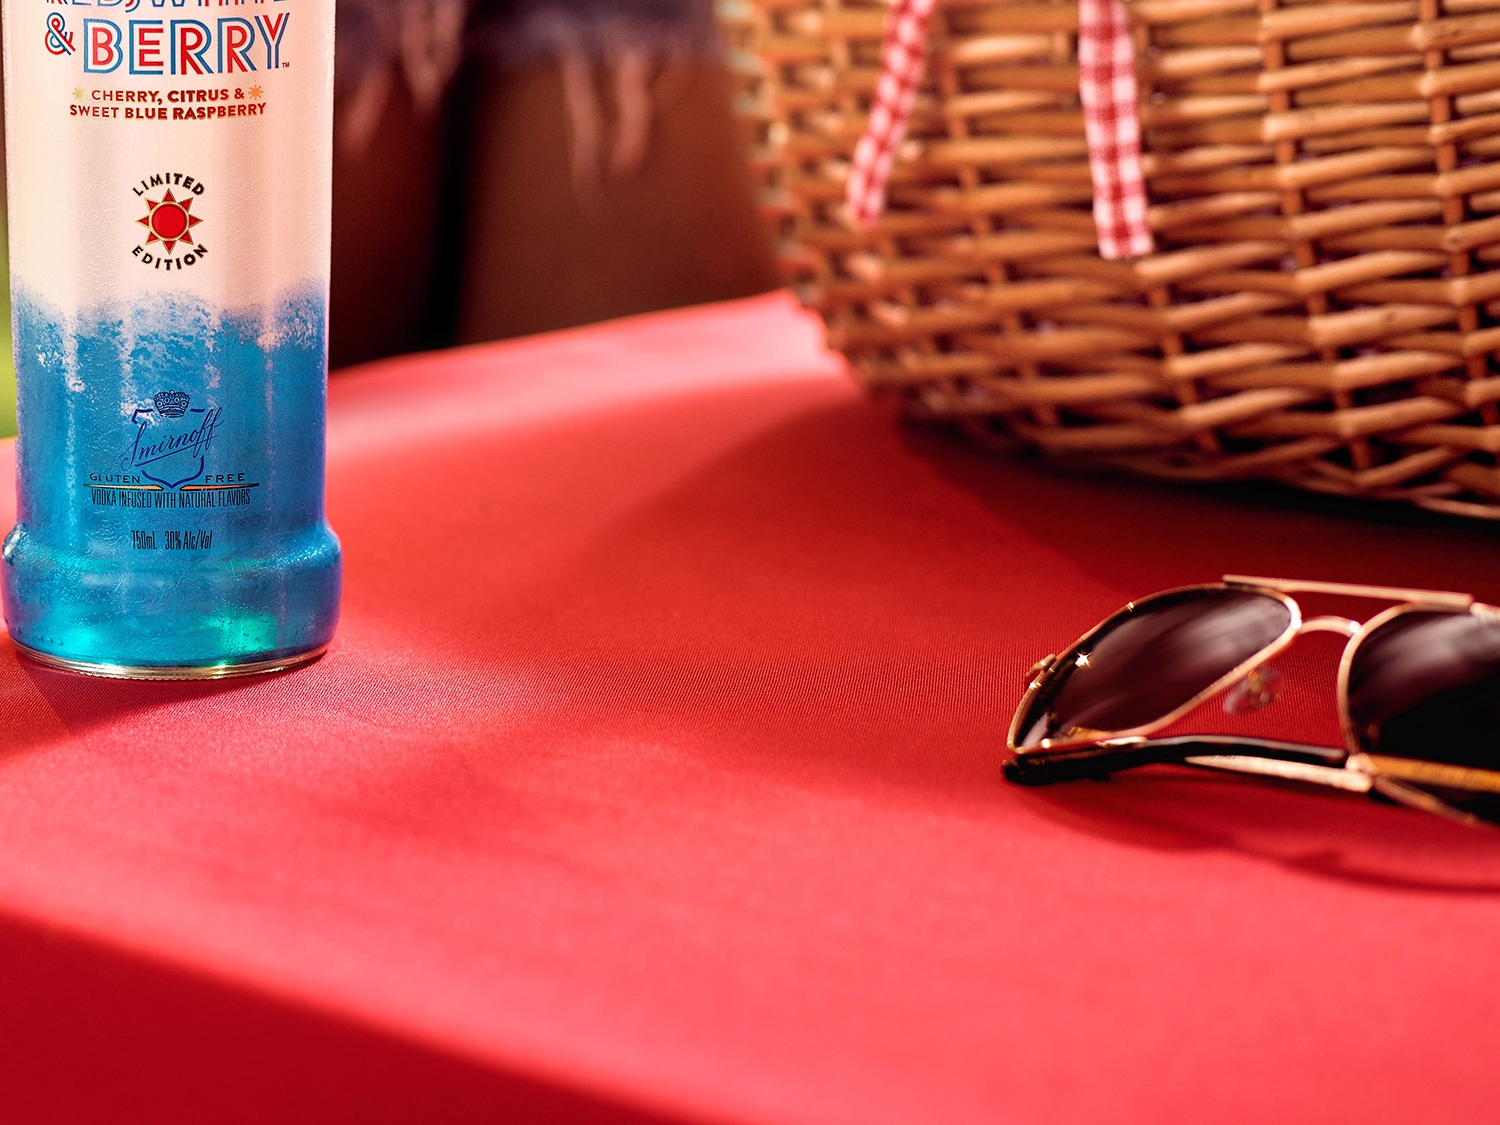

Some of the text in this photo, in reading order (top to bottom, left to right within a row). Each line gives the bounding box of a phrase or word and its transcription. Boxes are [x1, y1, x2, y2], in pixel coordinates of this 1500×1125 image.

[45, 11, 77, 56] &
[83, 12, 291, 76] BERRY
[91, 87, 245, 105] CHERRY, CITRUS &
[70, 102, 267, 121] SWEET BLUE RASPBERRY
[132, 172, 205, 197] LIMITED
[131, 243, 209, 272] EDITION
[118, 407, 225, 472] Smirnoff
[89, 472, 245, 484] GLUTEN FREE
[91, 488, 251, 509] VODKA INFUSED WITH NATURAL FLAVORS
[164, 530, 181, 551] 30%
[182, 528, 213, 552] Alc/Vol
